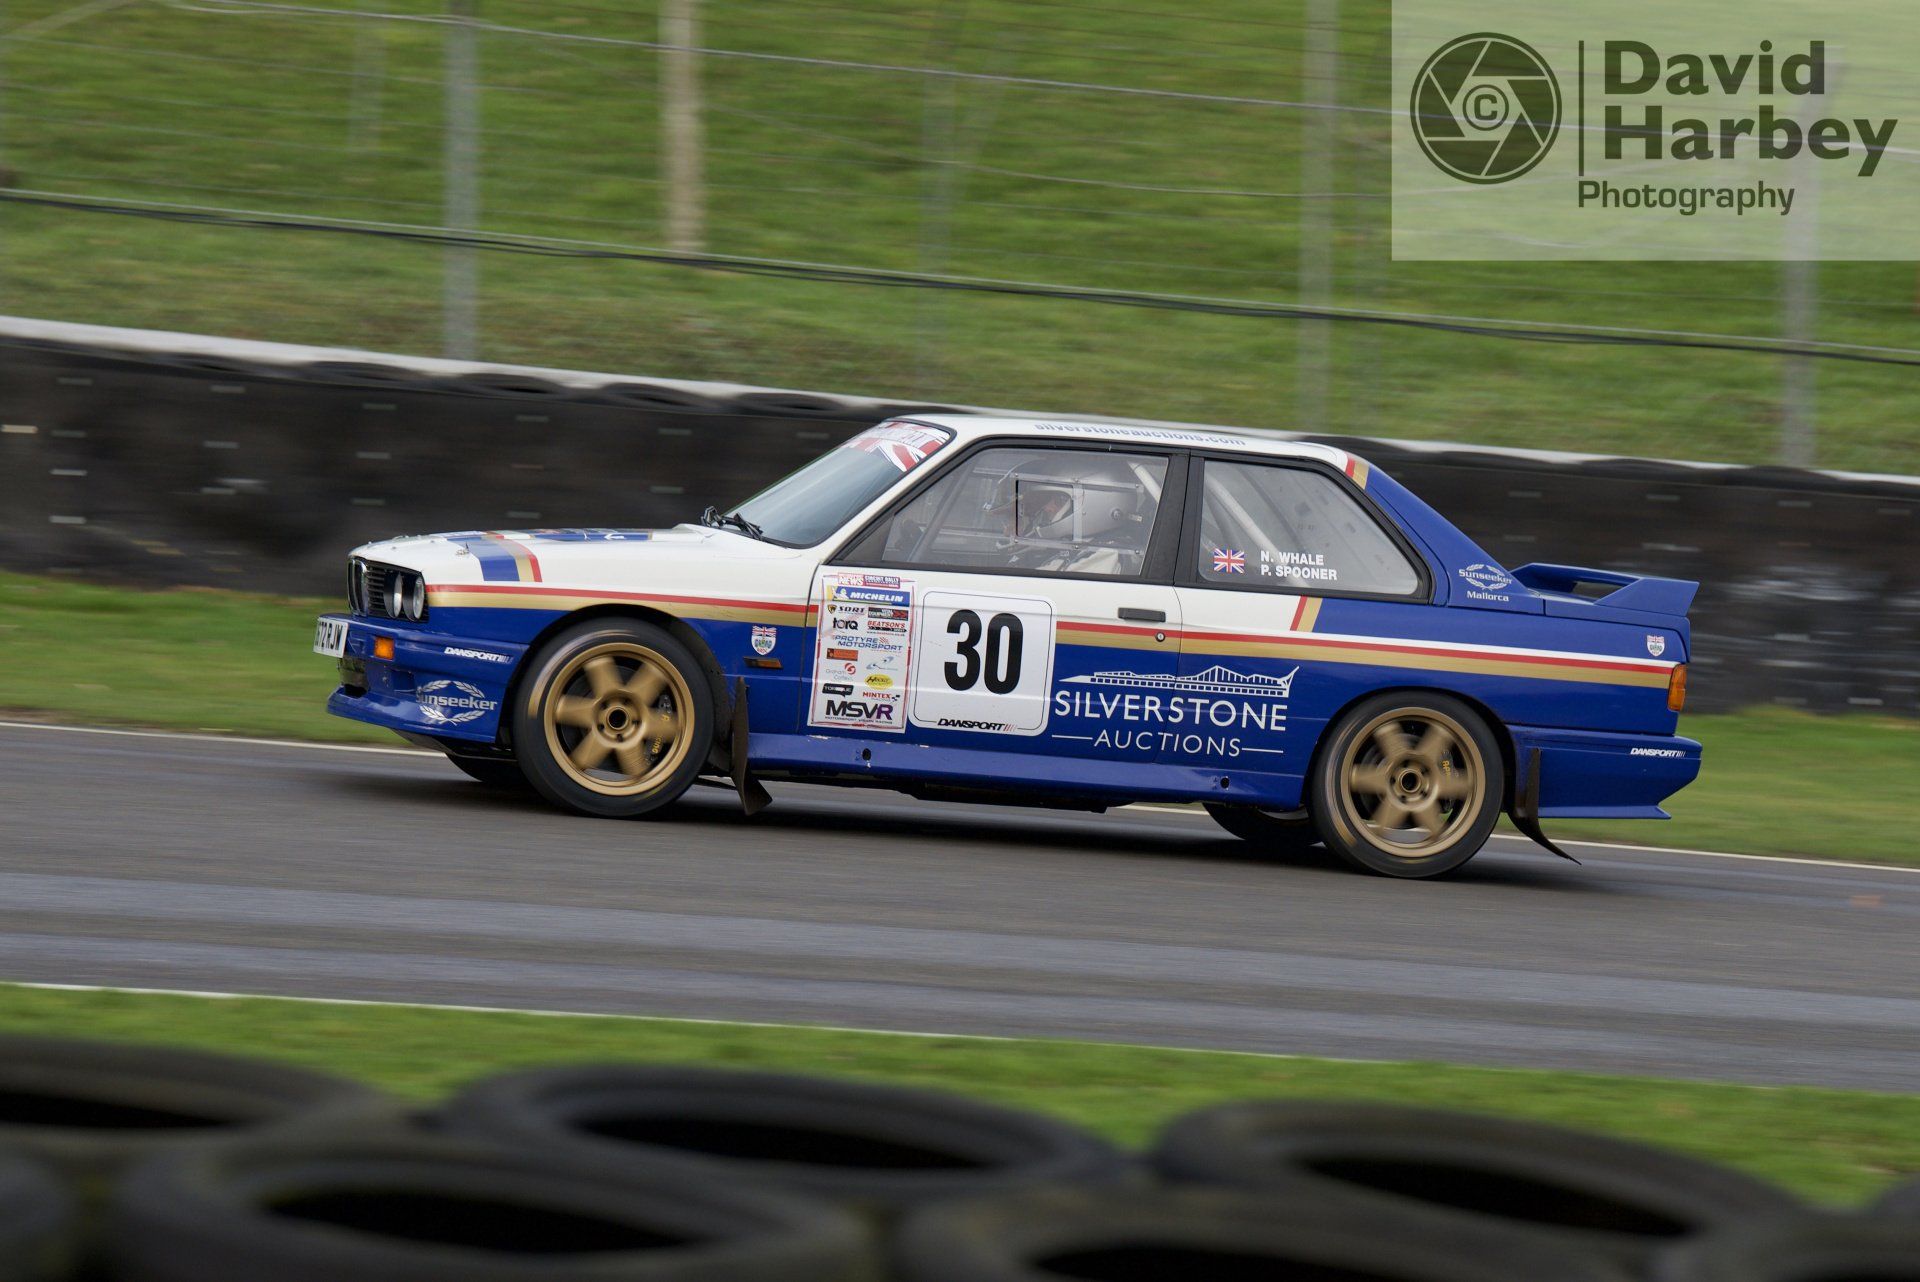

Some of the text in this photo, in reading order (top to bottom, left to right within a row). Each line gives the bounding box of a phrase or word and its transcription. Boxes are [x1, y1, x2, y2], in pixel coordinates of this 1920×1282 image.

[1034, 422, 1246, 447] silverstoneauctions.com
[1279, 551, 1324, 566] WHALE
[1275, 566, 1338, 581] SPOONER
[1458, 568, 1512, 585] Sunseeker
[850, 591, 904, 603] MICHELIN
[1466, 590, 1510, 602] Mallorca
[833, 635, 879, 644] PROTYRE
[837, 641, 904, 652] MOTORSPORT
[444, 646, 503, 662] DANSPORT
[944, 609, 1024, 695] 30
[415, 686, 498, 711] Sunseeker
[862, 691, 891, 699] MINTEX
[825, 699, 894, 720] MSVR
[1054, 690, 1288, 731] SILVERSTONE
[937, 718, 1006, 732] DANSPORT
[1093, 729, 1242, 757] AUCTIONS
[1630, 747, 1678, 758] DANSPORT
